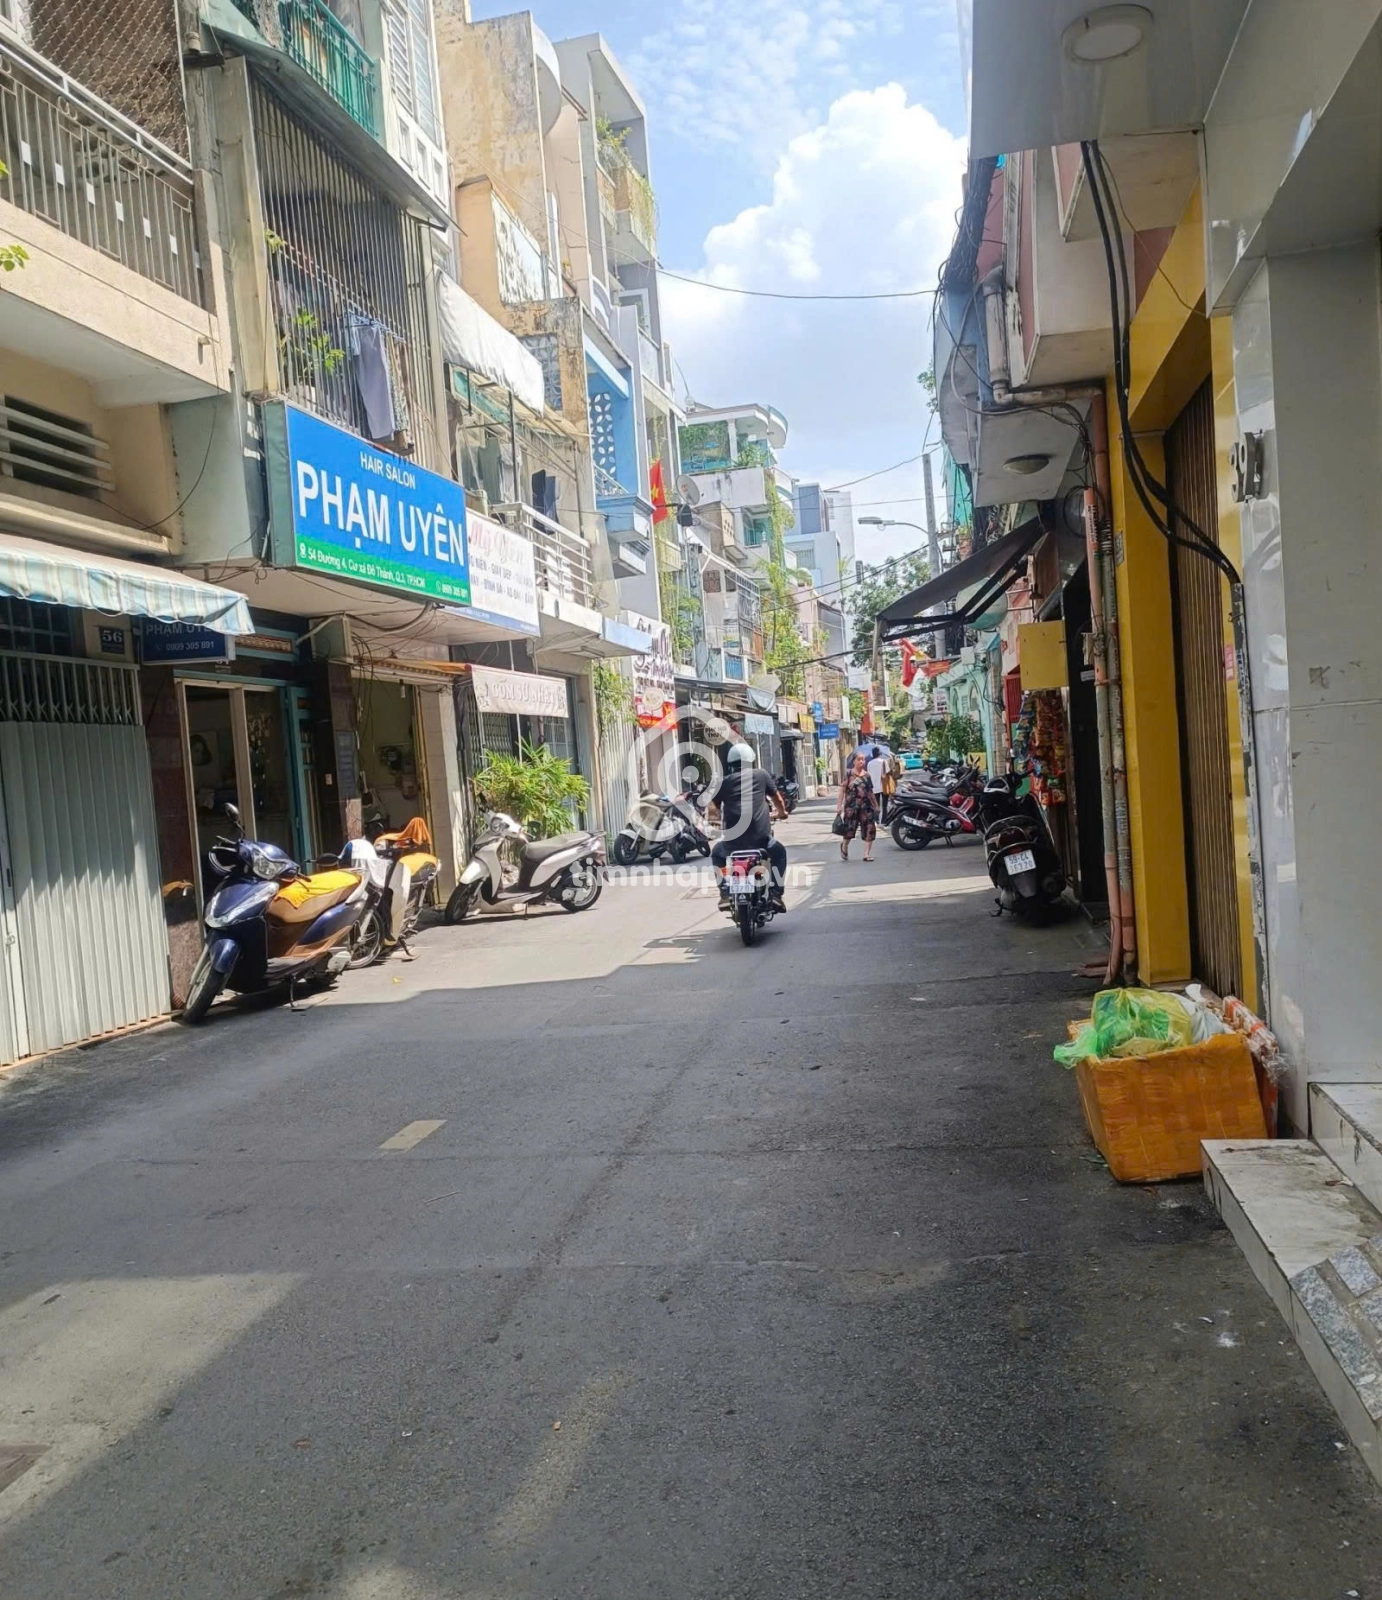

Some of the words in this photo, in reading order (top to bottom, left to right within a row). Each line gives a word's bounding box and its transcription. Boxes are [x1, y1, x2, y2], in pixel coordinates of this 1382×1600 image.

[360, 451, 384, 476] HAIR
[385, 463, 416, 490] SALON
[297, 460, 391, 548] PHẠM
[399, 503, 464, 567] UYÊN
[308, 547, 317, 560] 54
[318, 550, 340, 569] Đường
[103, 630, 122, 643] 56
[145, 622, 183, 637] PHẠM
[166, 642, 184, 651] 0909
[201, 641, 214, 649] 891
